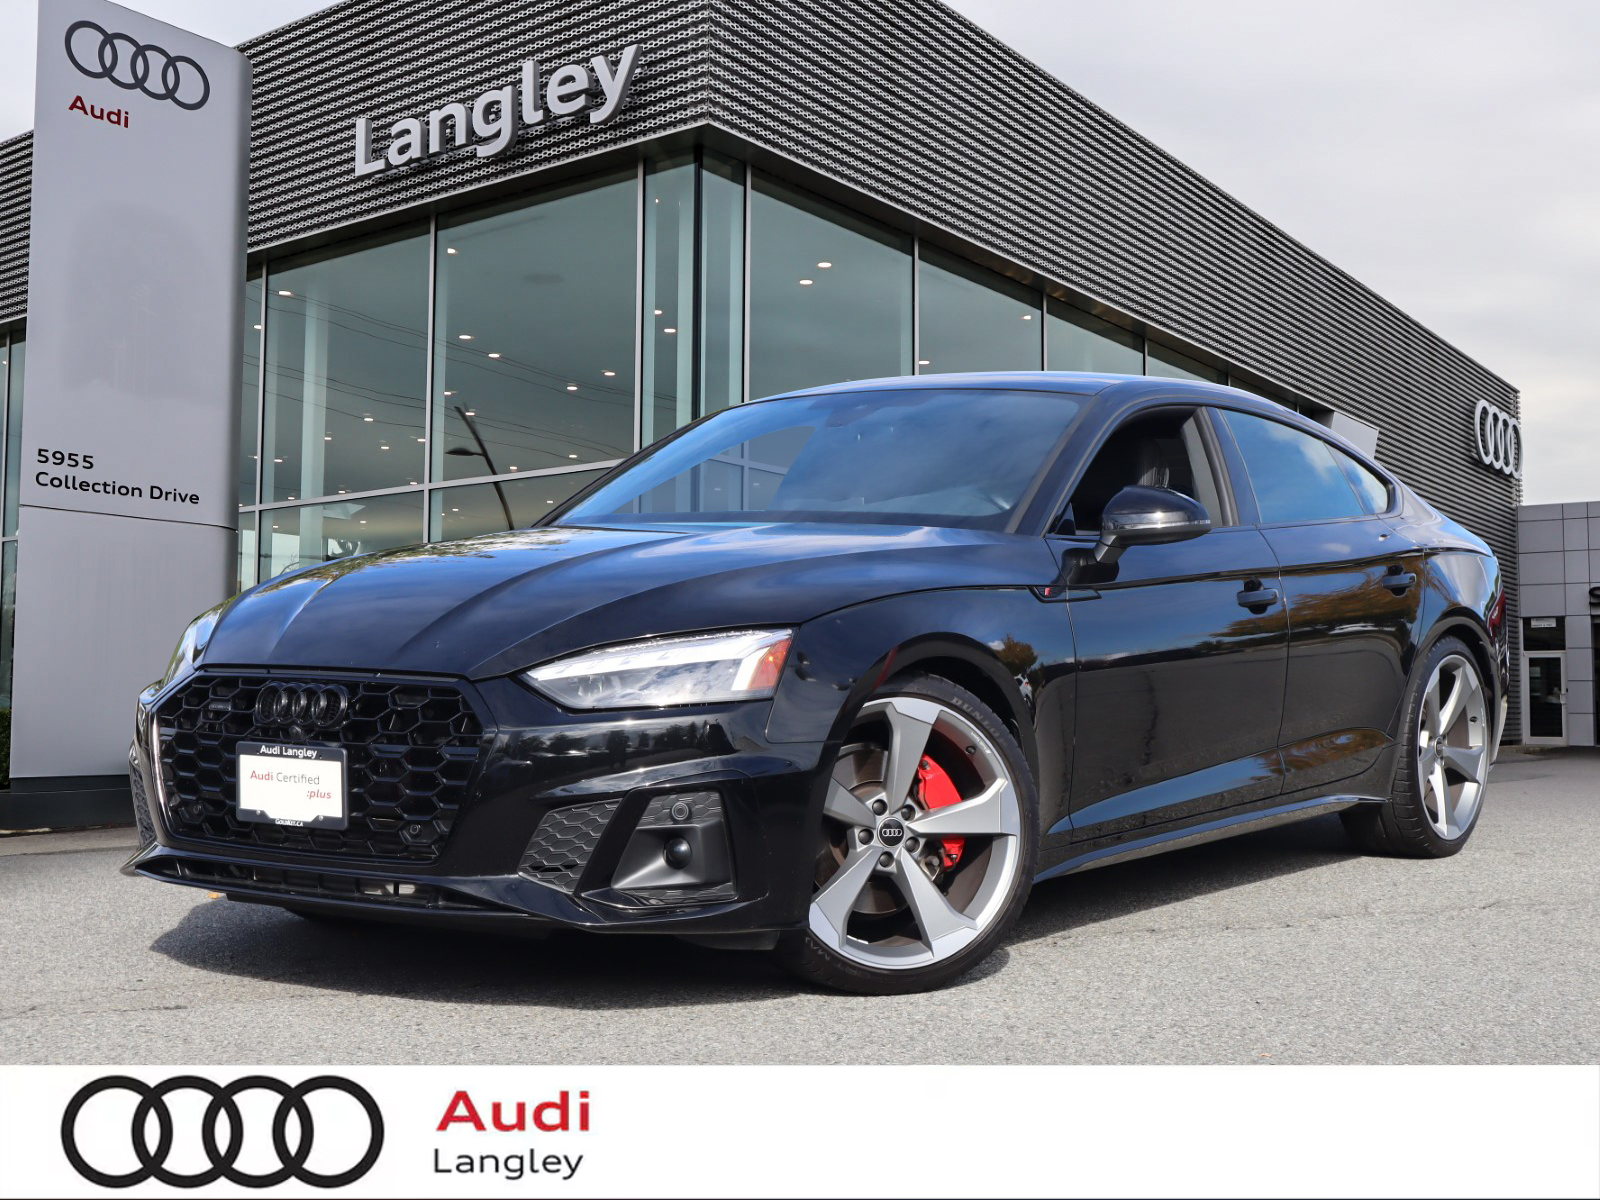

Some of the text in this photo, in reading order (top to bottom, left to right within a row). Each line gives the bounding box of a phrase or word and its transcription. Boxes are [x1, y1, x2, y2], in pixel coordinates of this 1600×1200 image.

[69, 95, 129, 128] Audi
[355, 44, 643, 176] Langley
[37, 448, 94, 469] 5955
[35, 471, 200, 504] Collection Drive
[260, 745, 318, 759] Audi Langley
[250, 770, 320, 785] Audi Certified
